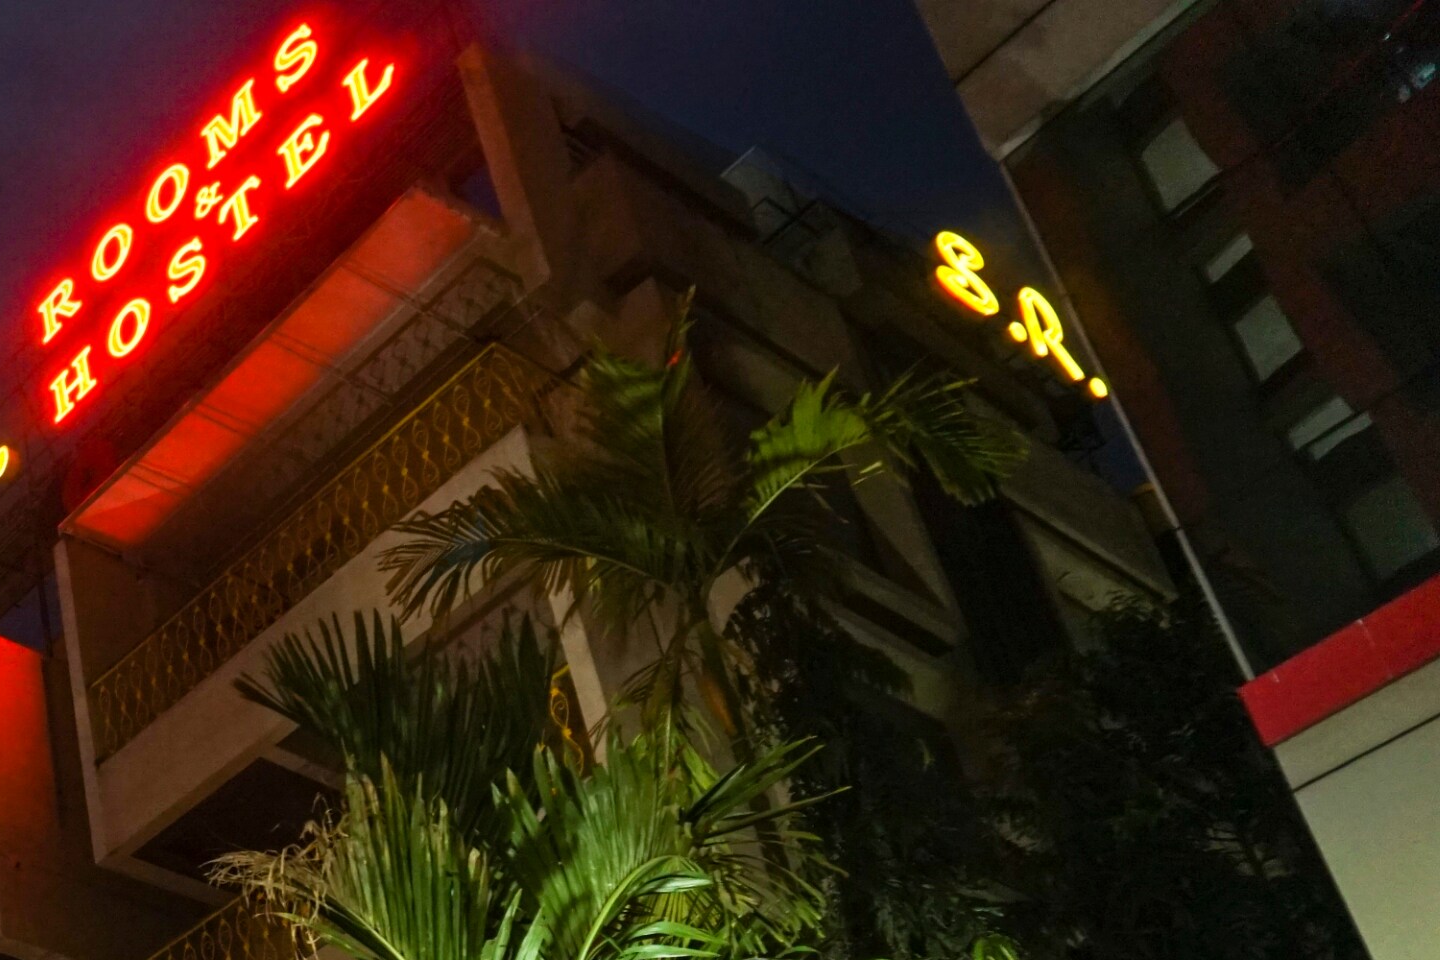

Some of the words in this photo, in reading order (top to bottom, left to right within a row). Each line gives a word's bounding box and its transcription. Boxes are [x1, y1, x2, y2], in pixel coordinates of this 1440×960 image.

[37, 22, 319, 345] ROOMS
[48, 57, 395, 425] HOSTEL
[194, 181, 224, 220] &
